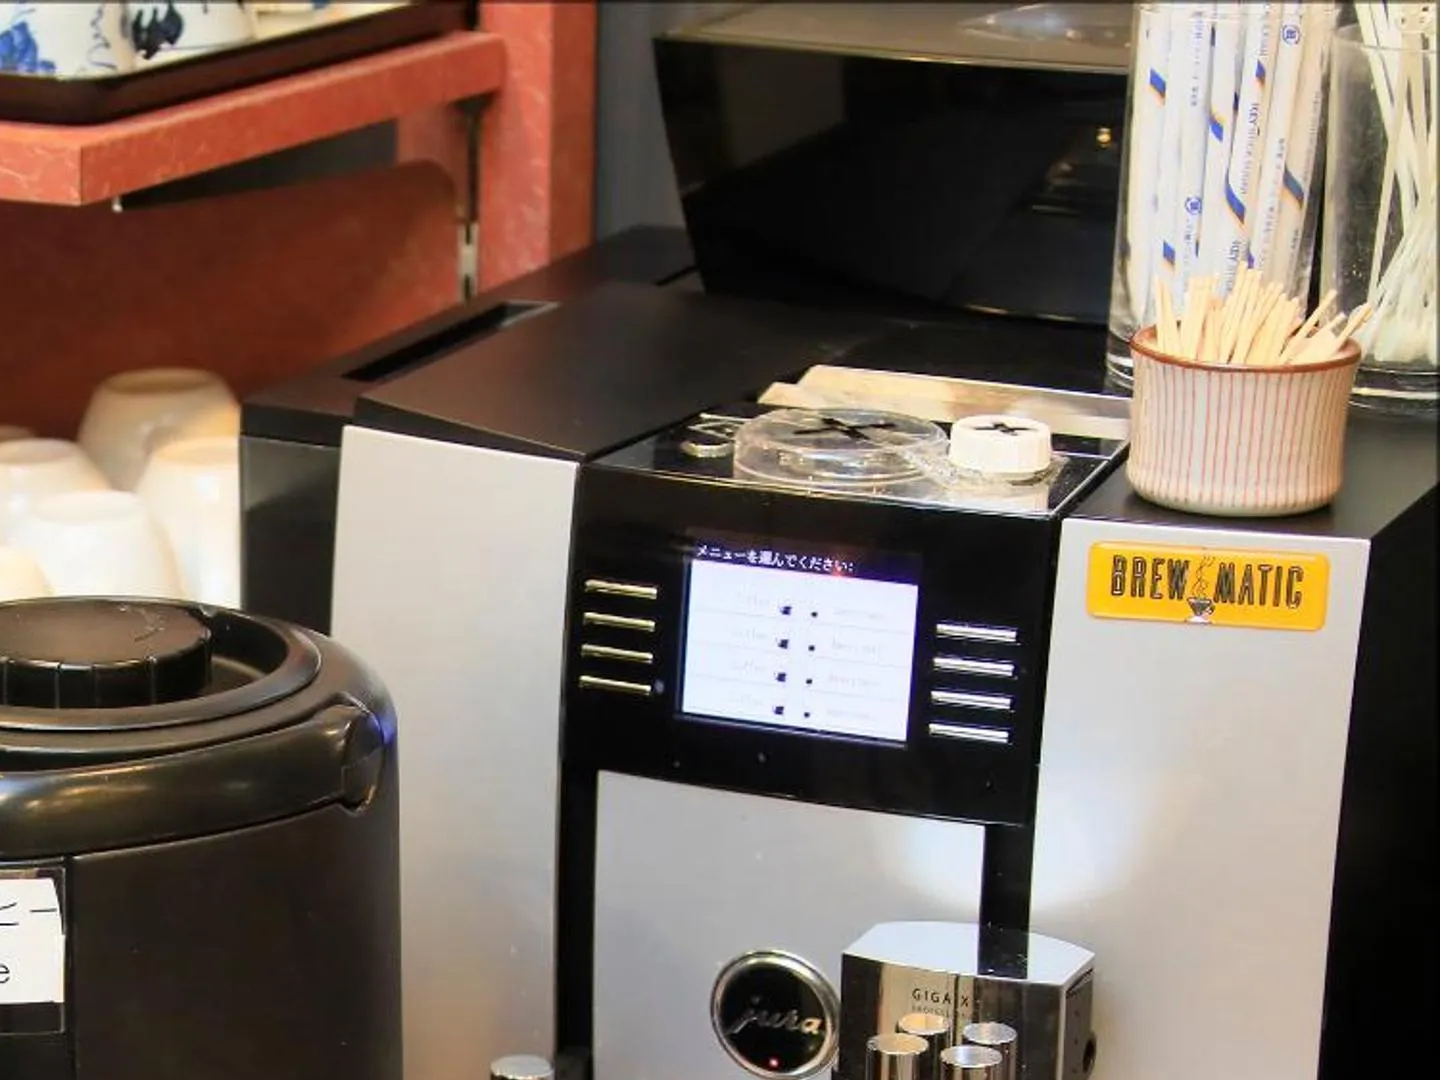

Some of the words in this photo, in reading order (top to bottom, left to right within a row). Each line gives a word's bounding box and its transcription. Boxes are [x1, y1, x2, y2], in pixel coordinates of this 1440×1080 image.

[1111, 554, 1190, 601] BREW
[1213, 561, 1305, 610] MATIC
[911, 987, 952, 1005] GIGA
